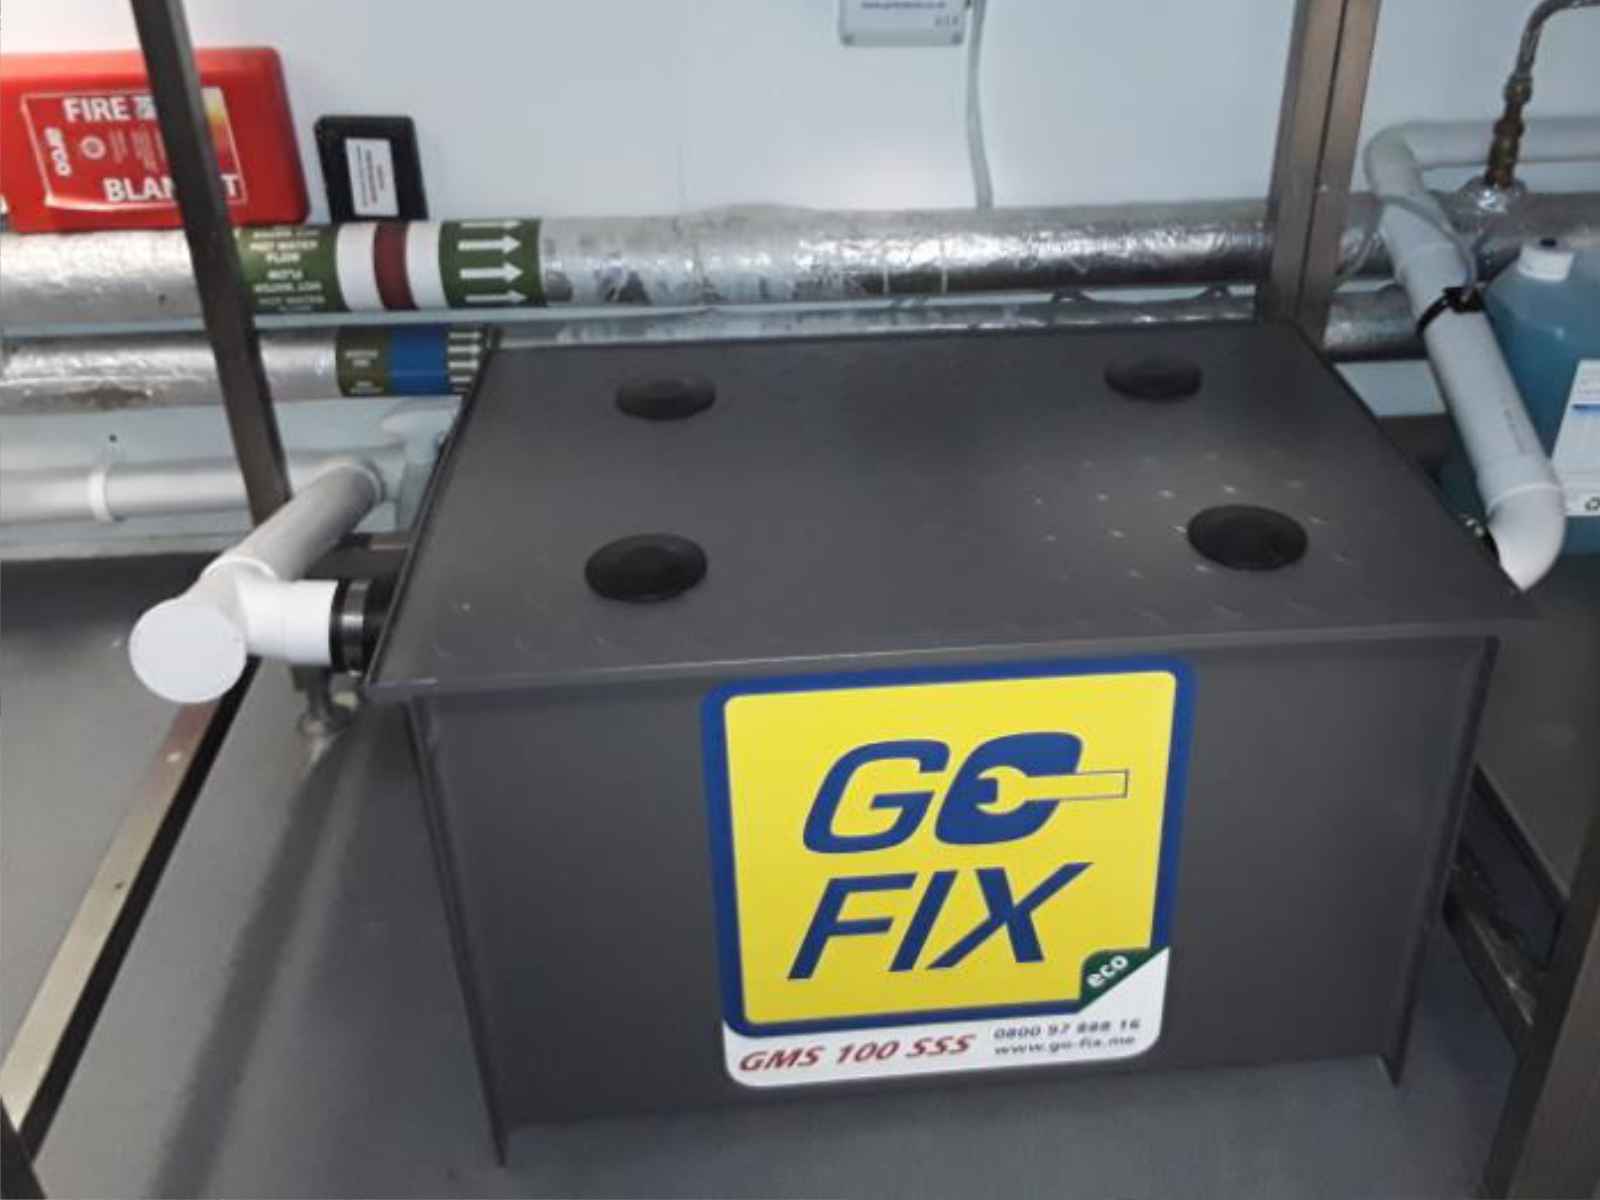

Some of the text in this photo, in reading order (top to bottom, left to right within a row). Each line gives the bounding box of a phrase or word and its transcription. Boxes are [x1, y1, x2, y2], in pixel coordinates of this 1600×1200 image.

[63, 97, 130, 123] FIRE
[803, 731, 1084, 854] GO
[787, 861, 1096, 981] FIX
[1086, 955, 1129, 988] eco
[993, 1024, 1042, 1040] 0800
[1048, 1023, 1070, 1036] 97
[1120, 1018, 1141, 1031] 16
[993, 1036, 1136, 1055] www.go-fix.me
[739, 1034, 977, 1072] GMS 100 SSS
